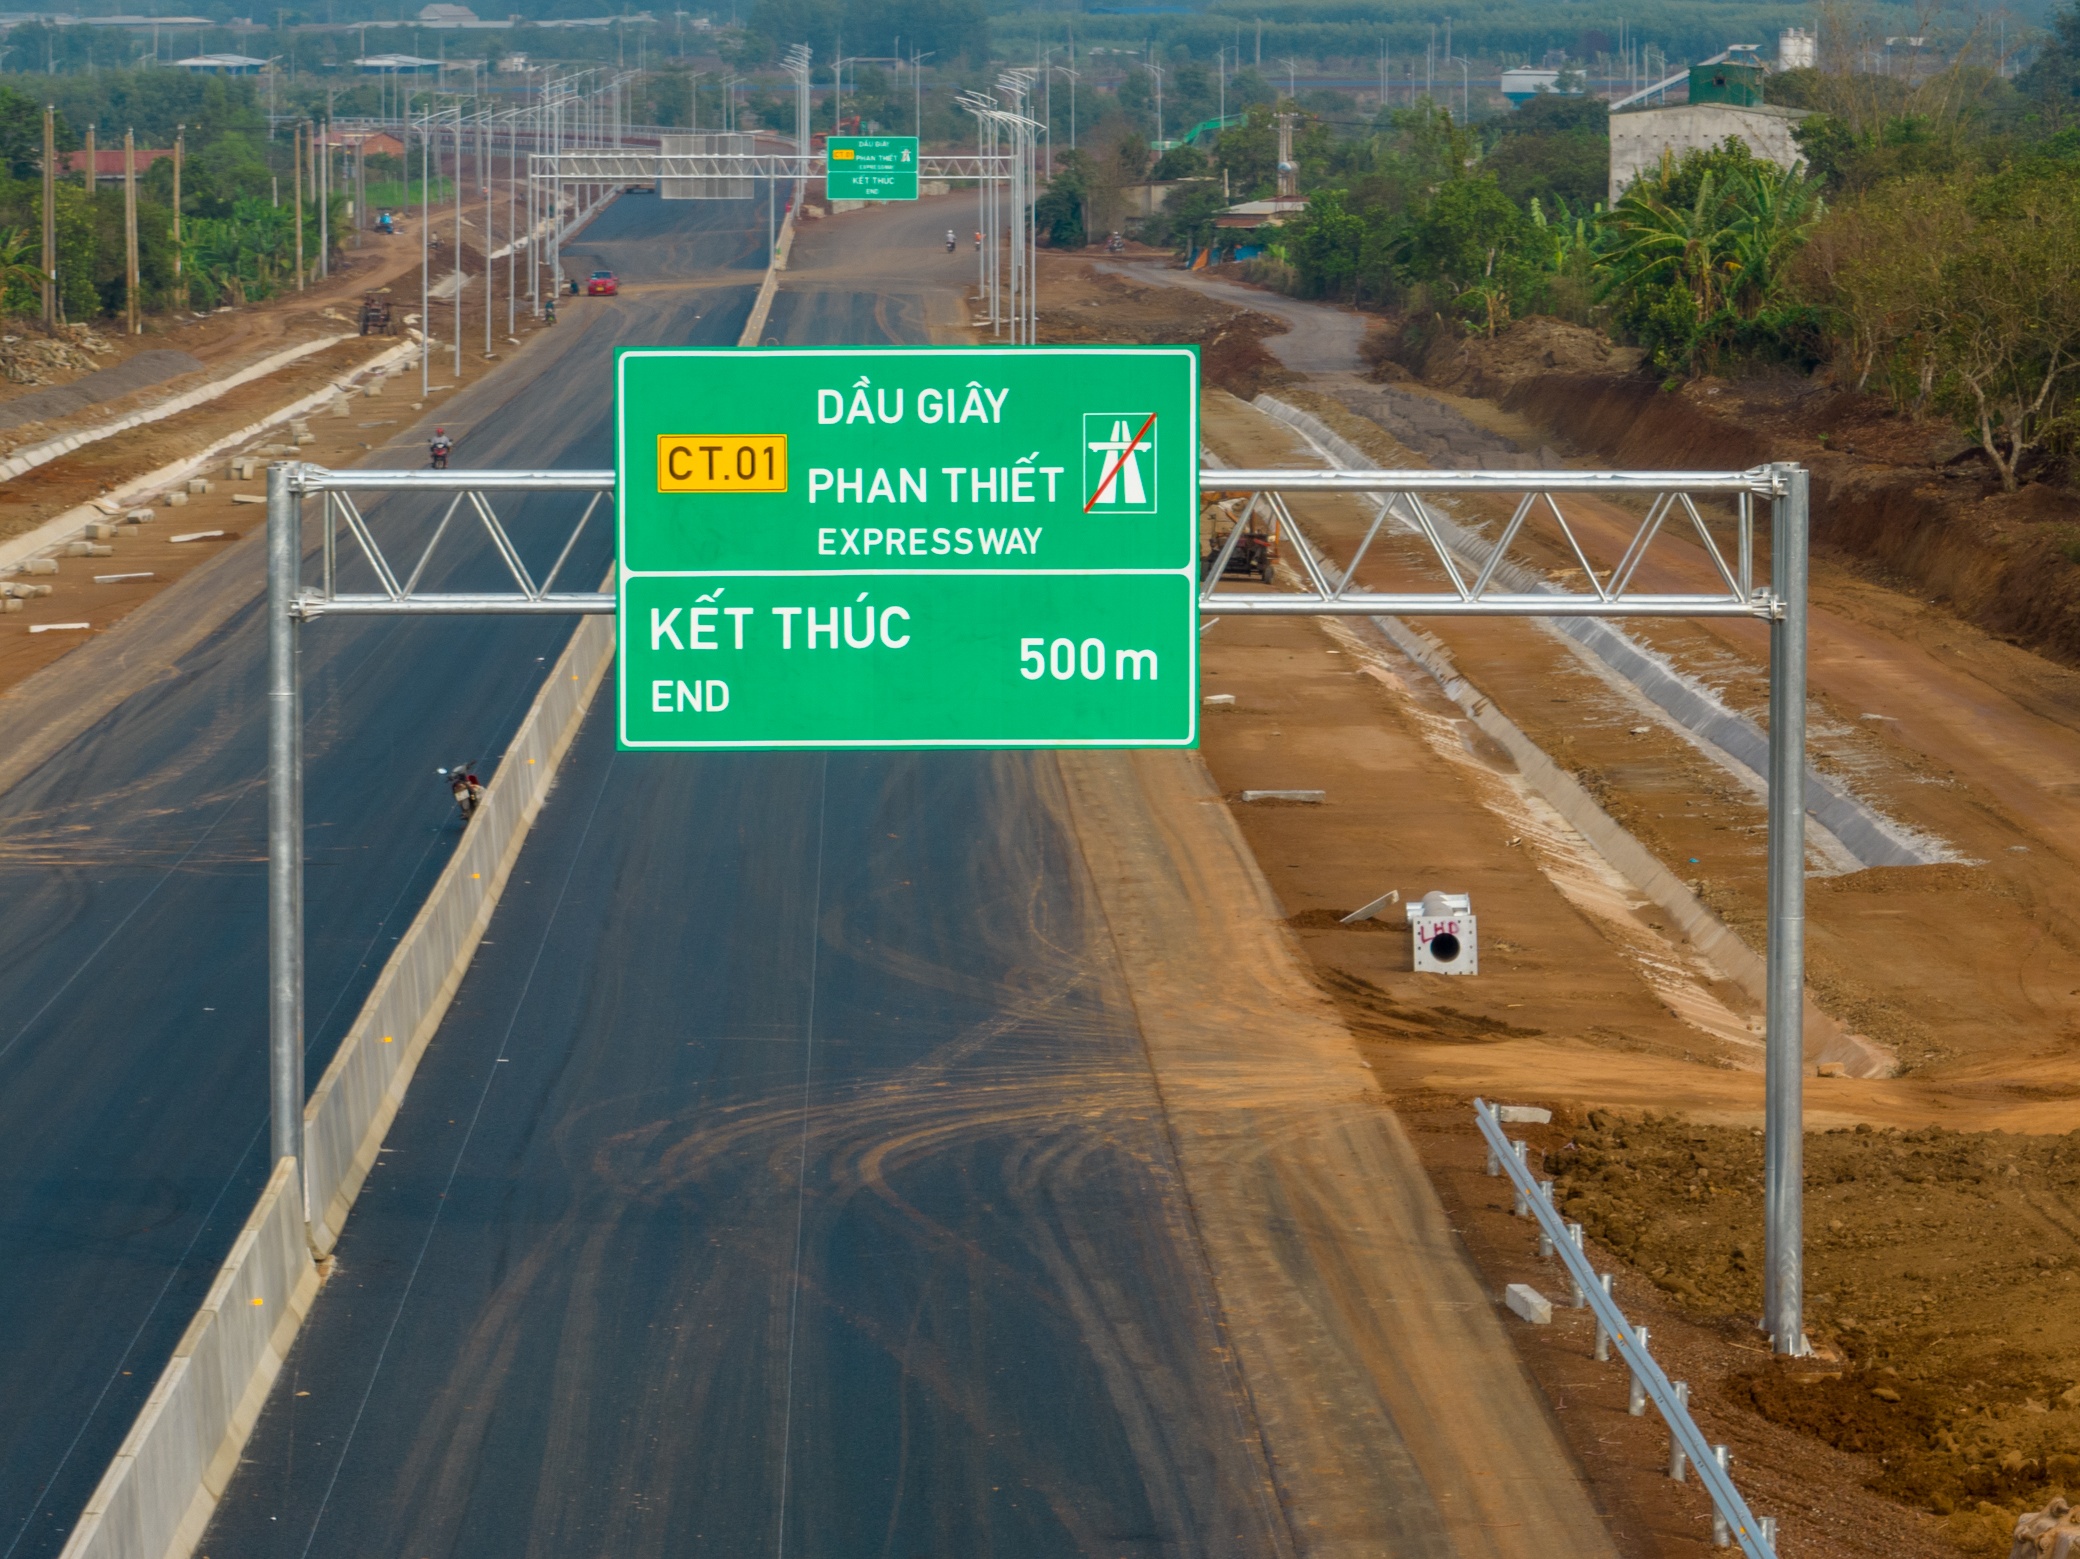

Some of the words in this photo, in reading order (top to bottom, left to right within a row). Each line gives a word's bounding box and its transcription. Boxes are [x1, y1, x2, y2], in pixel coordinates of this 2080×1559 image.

[817, 375, 904, 425] DẦU
[917, 380, 1009, 424] GIÂY
[668, 445, 774, 481] CT.01
[808, 467, 927, 504] PHAN
[941, 451, 1065, 503] THIẾT
[818, 527, 1043, 556] EXPRESSWAY
[651, 587, 754, 651] KẾT
[771, 591, 911, 650] THÚC
[652, 679, 730, 713] END
